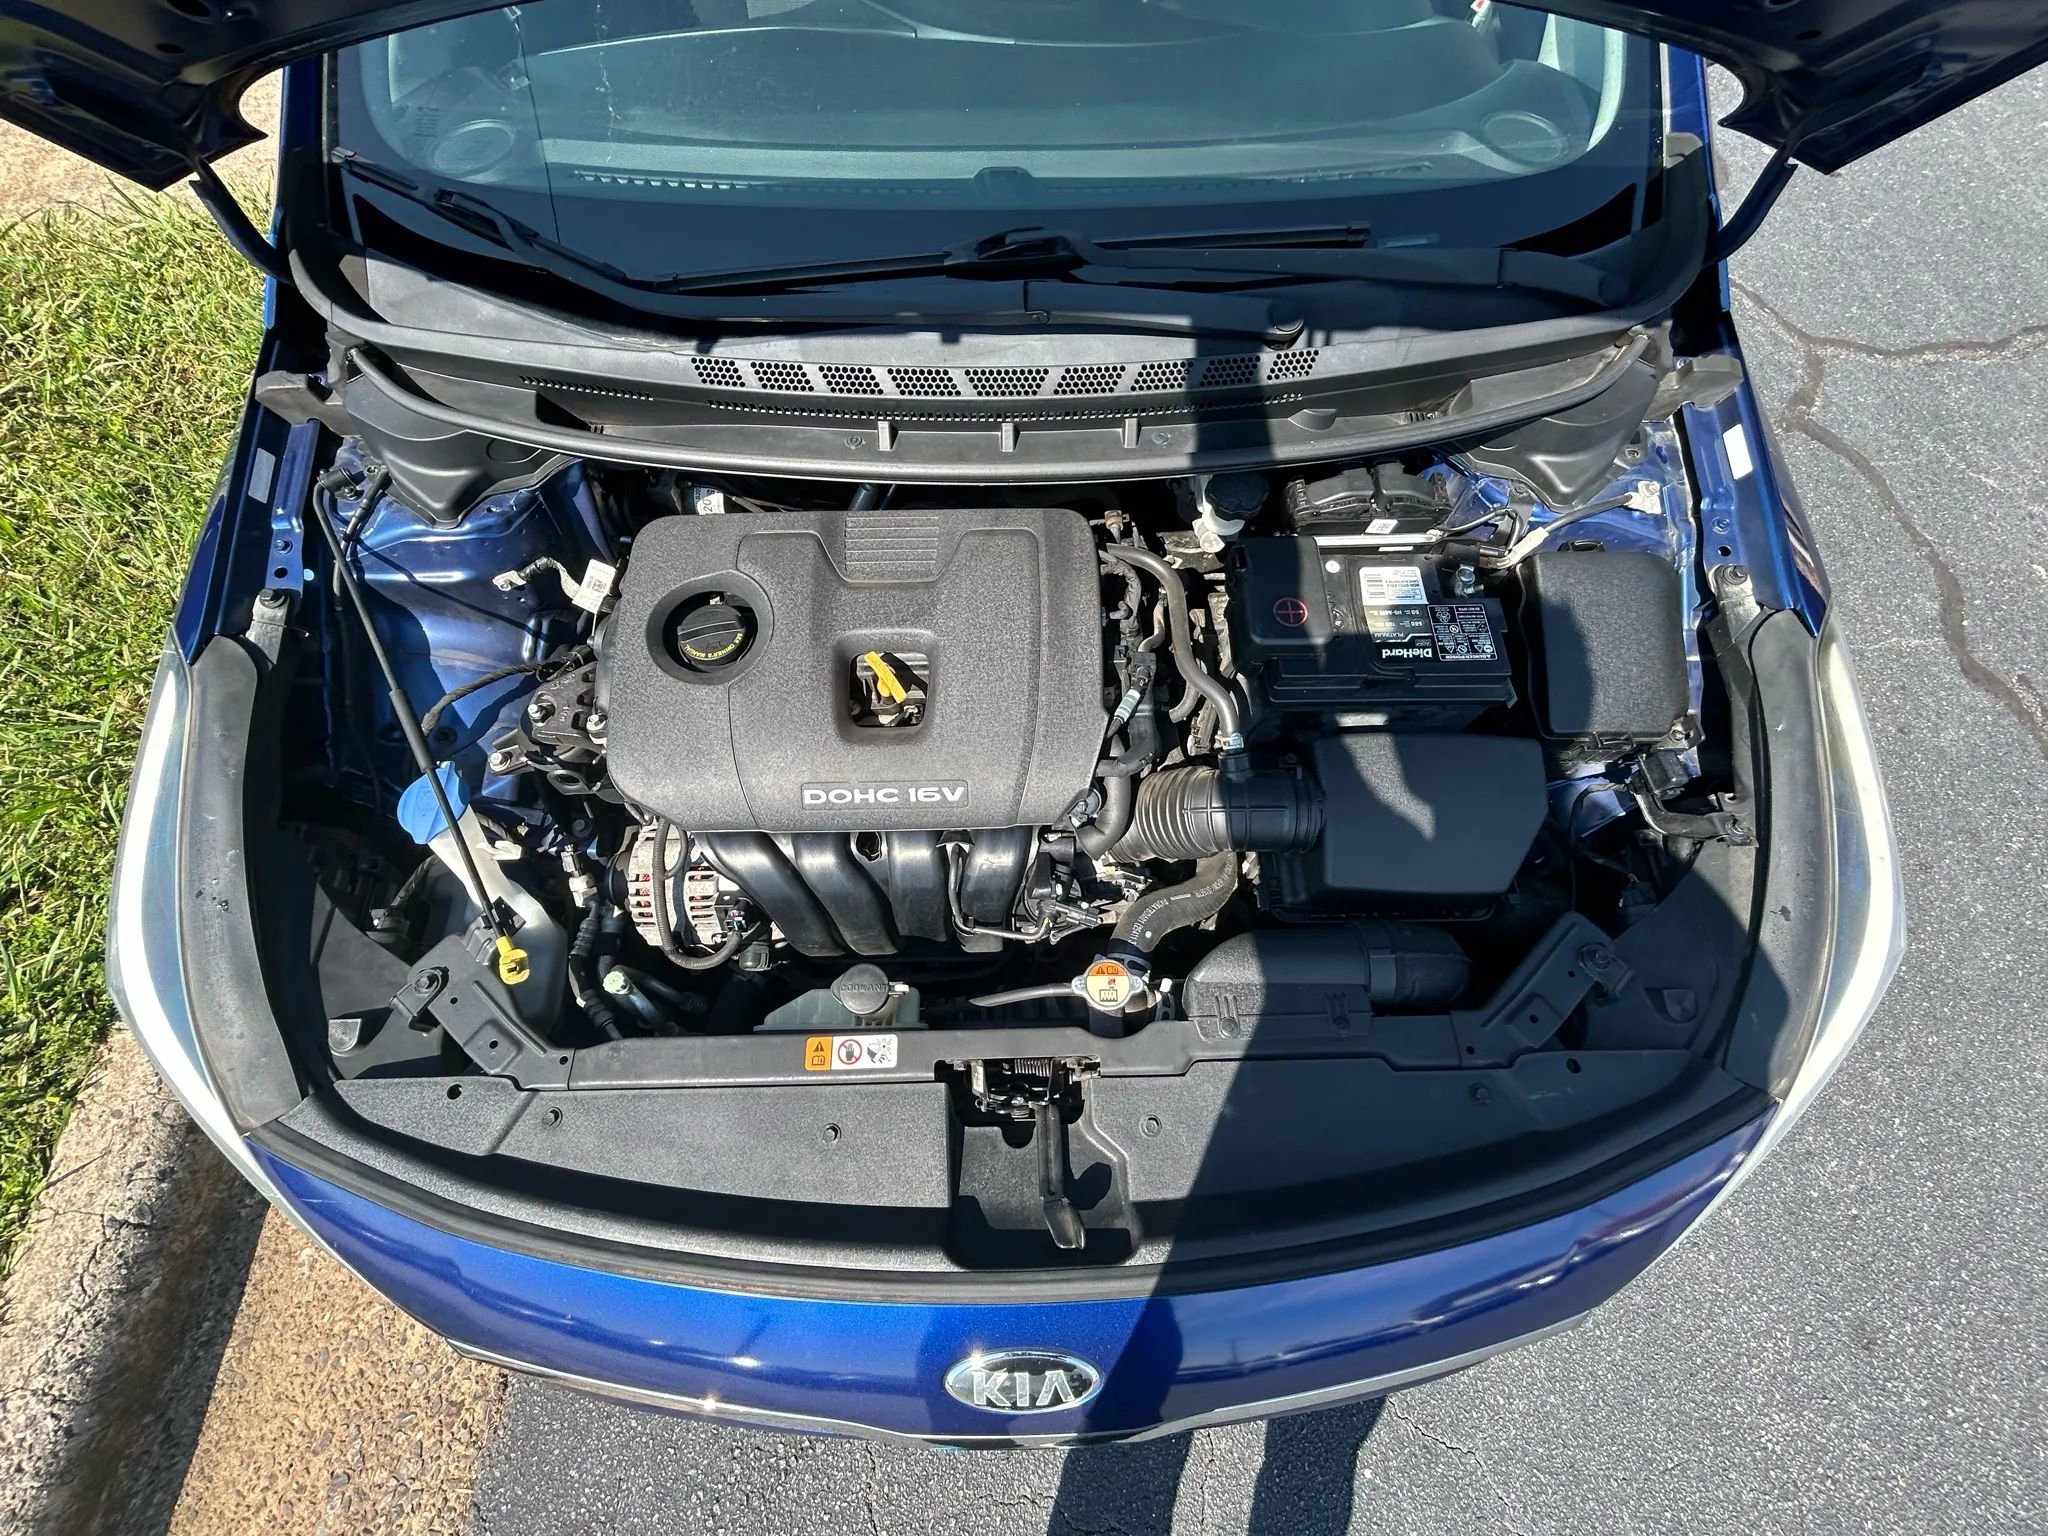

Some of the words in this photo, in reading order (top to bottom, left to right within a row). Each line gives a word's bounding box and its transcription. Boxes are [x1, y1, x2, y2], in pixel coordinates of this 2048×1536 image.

[733, 633, 743, 644] SEE
[684, 644, 706, 658] MANUAL
[708, 644, 735, 658] OWNER'S
[1382, 648, 1433, 659] DieHard
[803, 788, 900, 805] DOHC
[908, 786, 965, 803] 16V
[840, 983, 889, 993] COOLANT
[971, 1368, 1076, 1407] KIA
